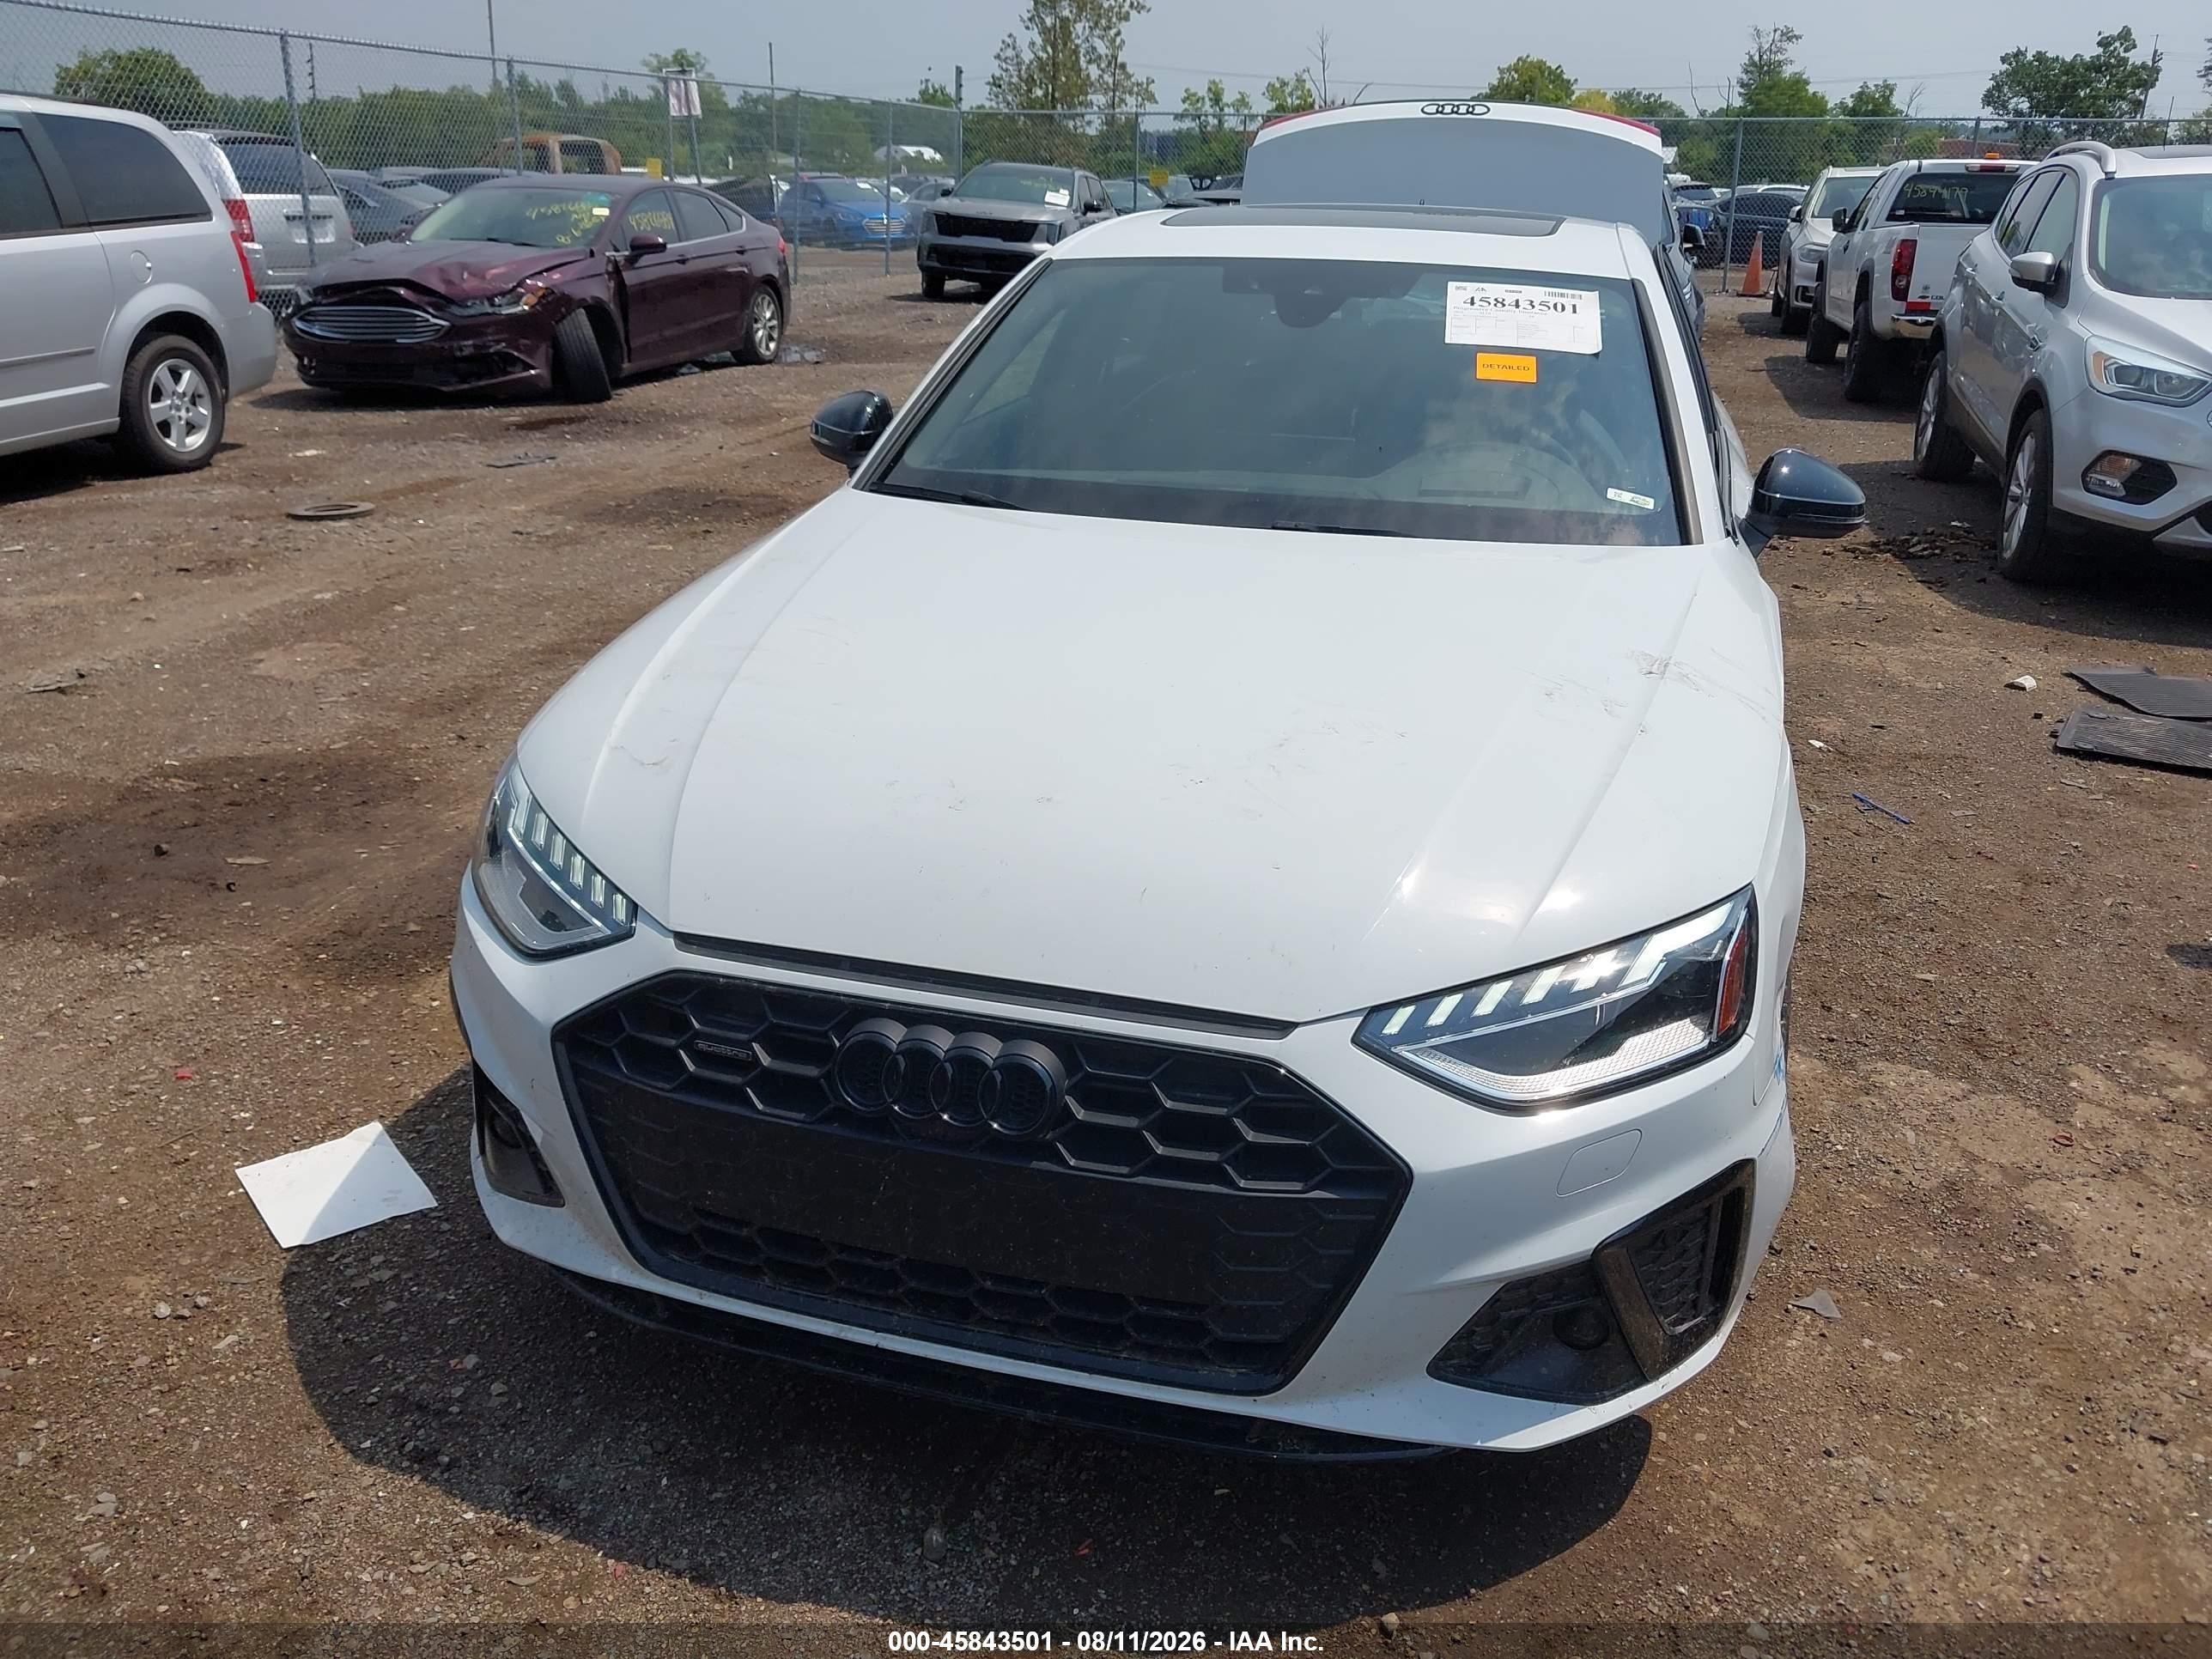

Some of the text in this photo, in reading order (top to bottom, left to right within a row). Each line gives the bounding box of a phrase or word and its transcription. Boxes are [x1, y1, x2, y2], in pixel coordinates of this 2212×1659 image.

[1462, 295, 1578, 315] 45843501
[1482, 363, 1530, 372] DETAILED
[697, 1042, 747, 1059] quattro
